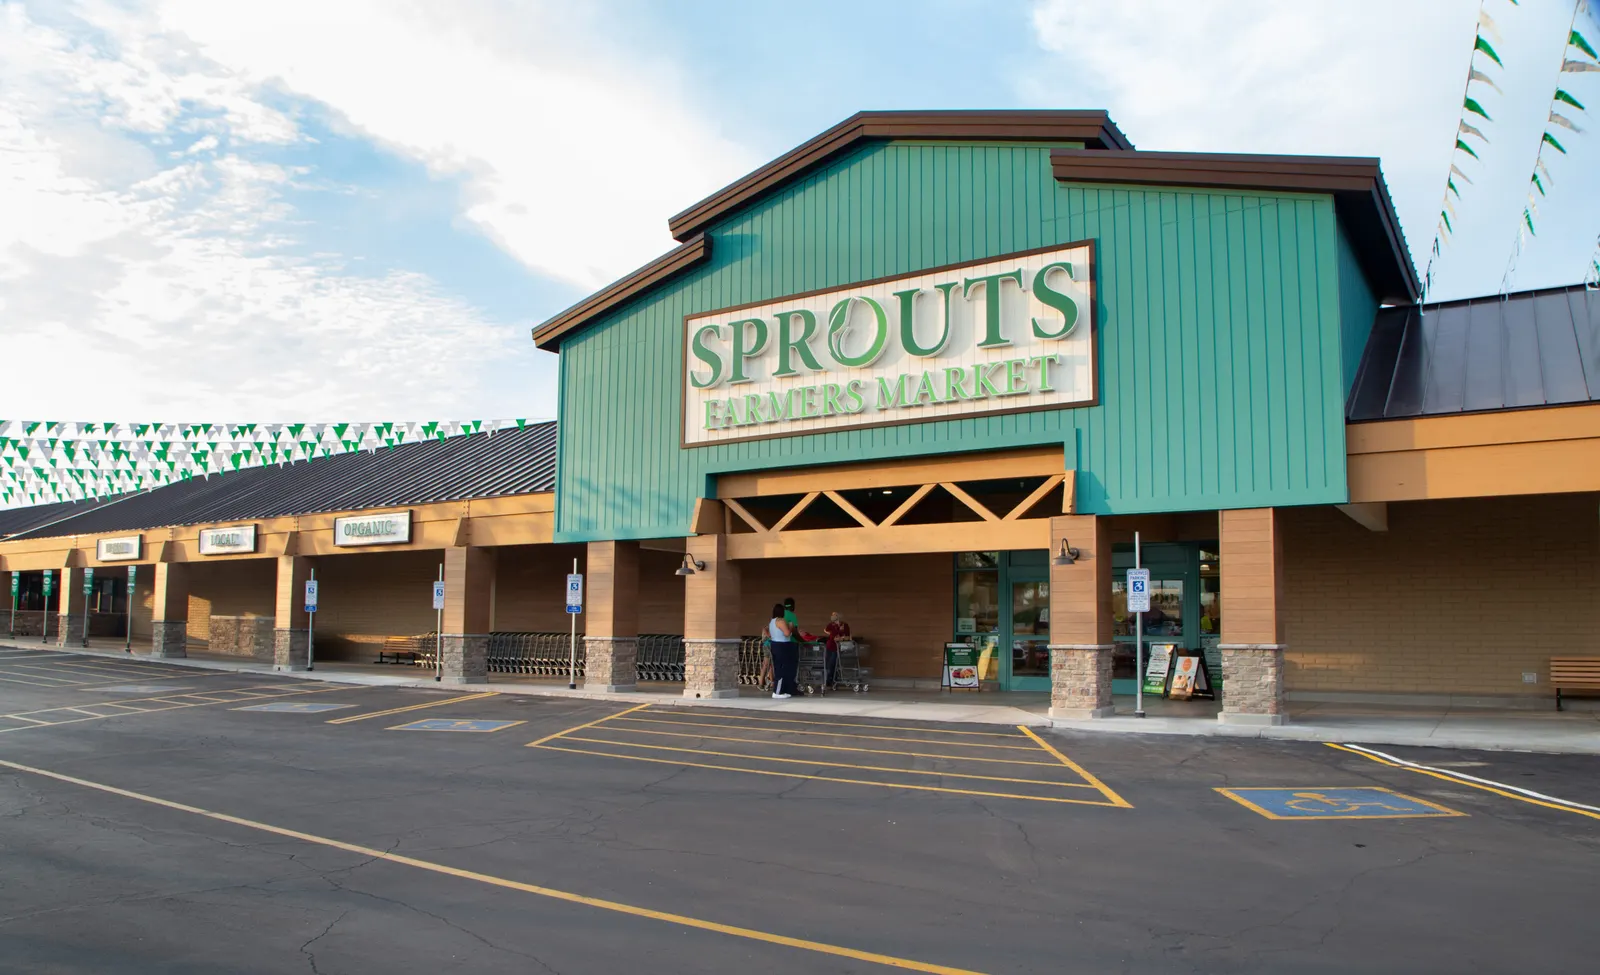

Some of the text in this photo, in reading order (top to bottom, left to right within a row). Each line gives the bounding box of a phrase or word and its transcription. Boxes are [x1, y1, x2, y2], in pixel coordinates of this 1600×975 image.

[690, 262, 1080, 389] SPROUTS
[703, 353, 1060, 430] FARMERS MARKET
[210, 533, 238, 546] LOCAL
[344, 520, 394, 537] ORGANIC
